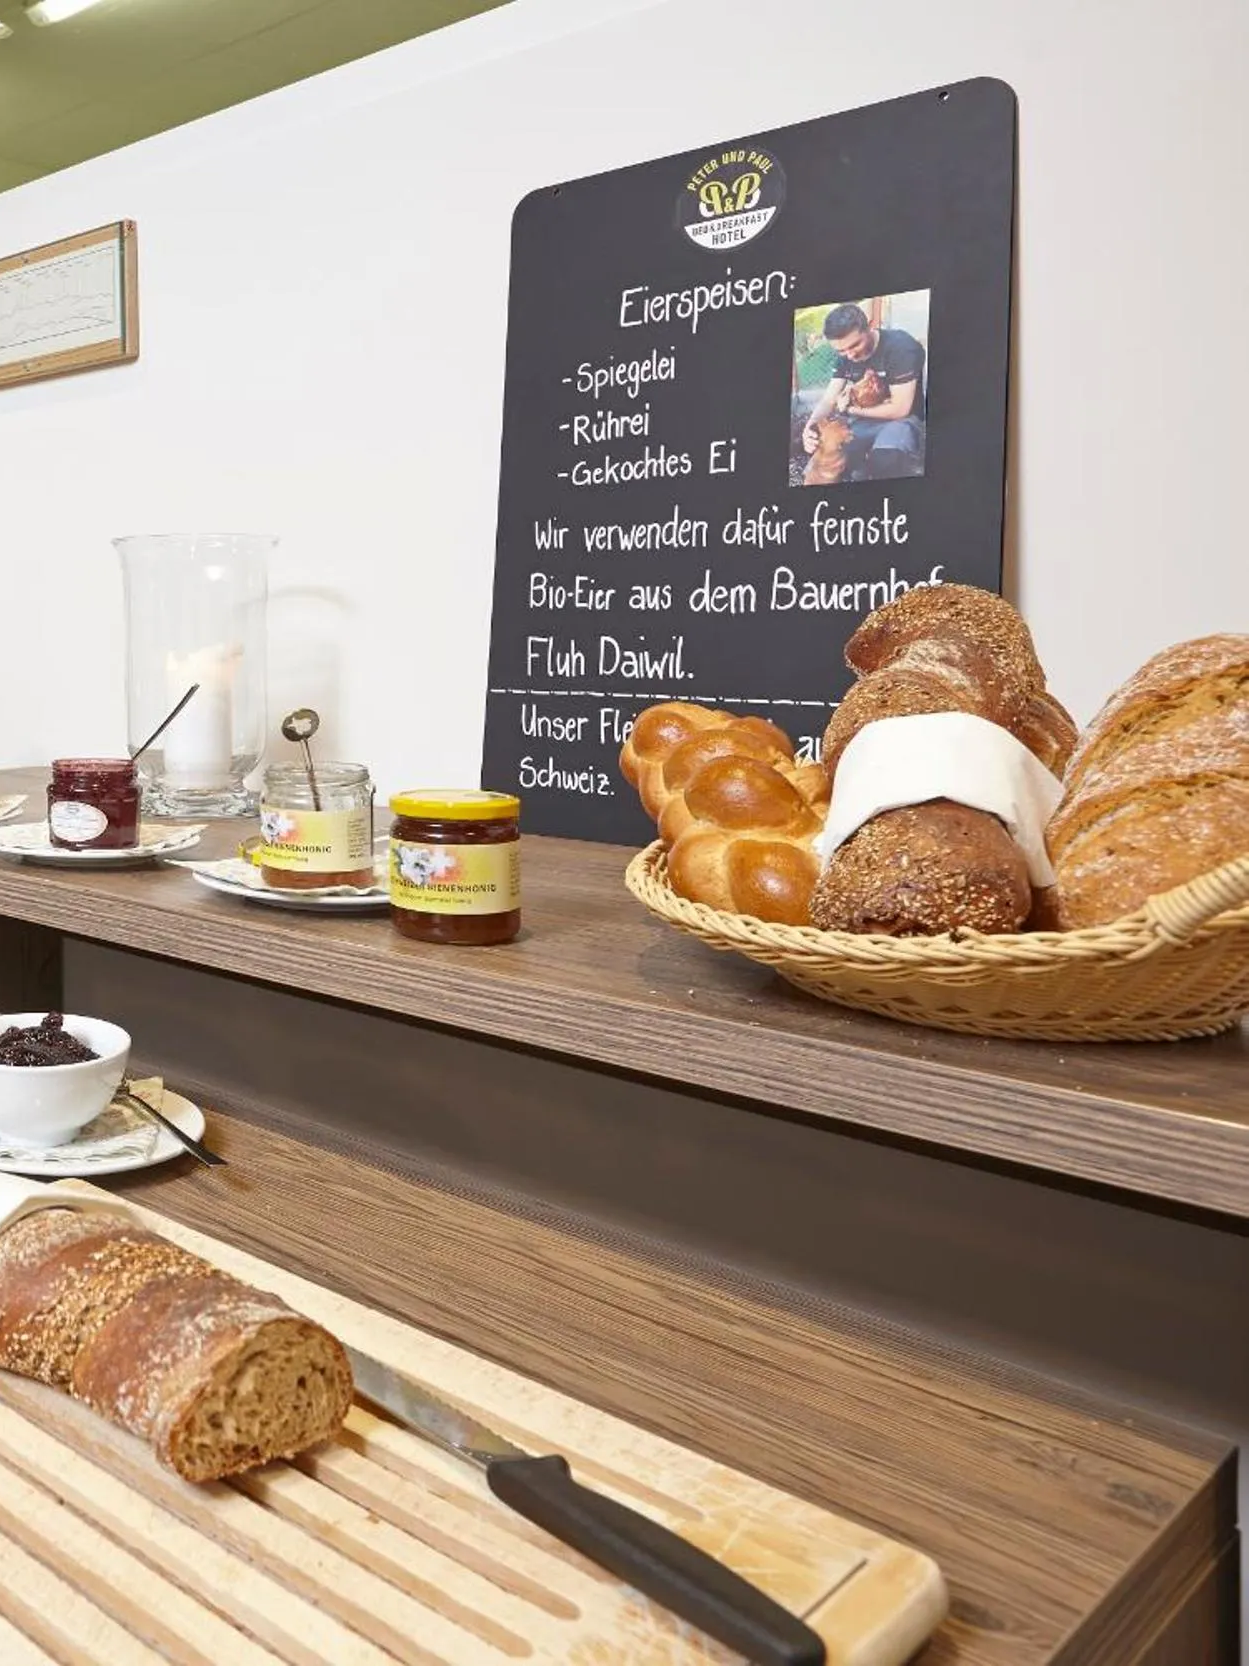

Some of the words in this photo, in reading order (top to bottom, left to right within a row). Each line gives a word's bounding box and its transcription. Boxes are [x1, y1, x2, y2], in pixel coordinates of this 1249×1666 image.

[687, 159, 719, 191] PETER
[721, 150, 746, 165] UND
[747, 151, 774, 174] PAUL
[711, 228, 747, 245] HOTEL
[619, 267, 797, 334] Eierspeisen:
[709, 438, 737, 474] Ei
[535, 517, 569, 550] Wir
[583, 504, 709, 552] verwenden
[722, 505, 795, 549] dafür
[809, 497, 909, 553] feinste
[529, 572, 616, 611] Bio-Eier
[628, 584, 672, 611] aus
[688, 569, 757, 615] dem
[527, 636, 586, 680] Fluh
[598, 635, 695, 680] Daiwil.
[521, 703, 589, 742] Unser
[519, 756, 615, 796] Schweiz.
